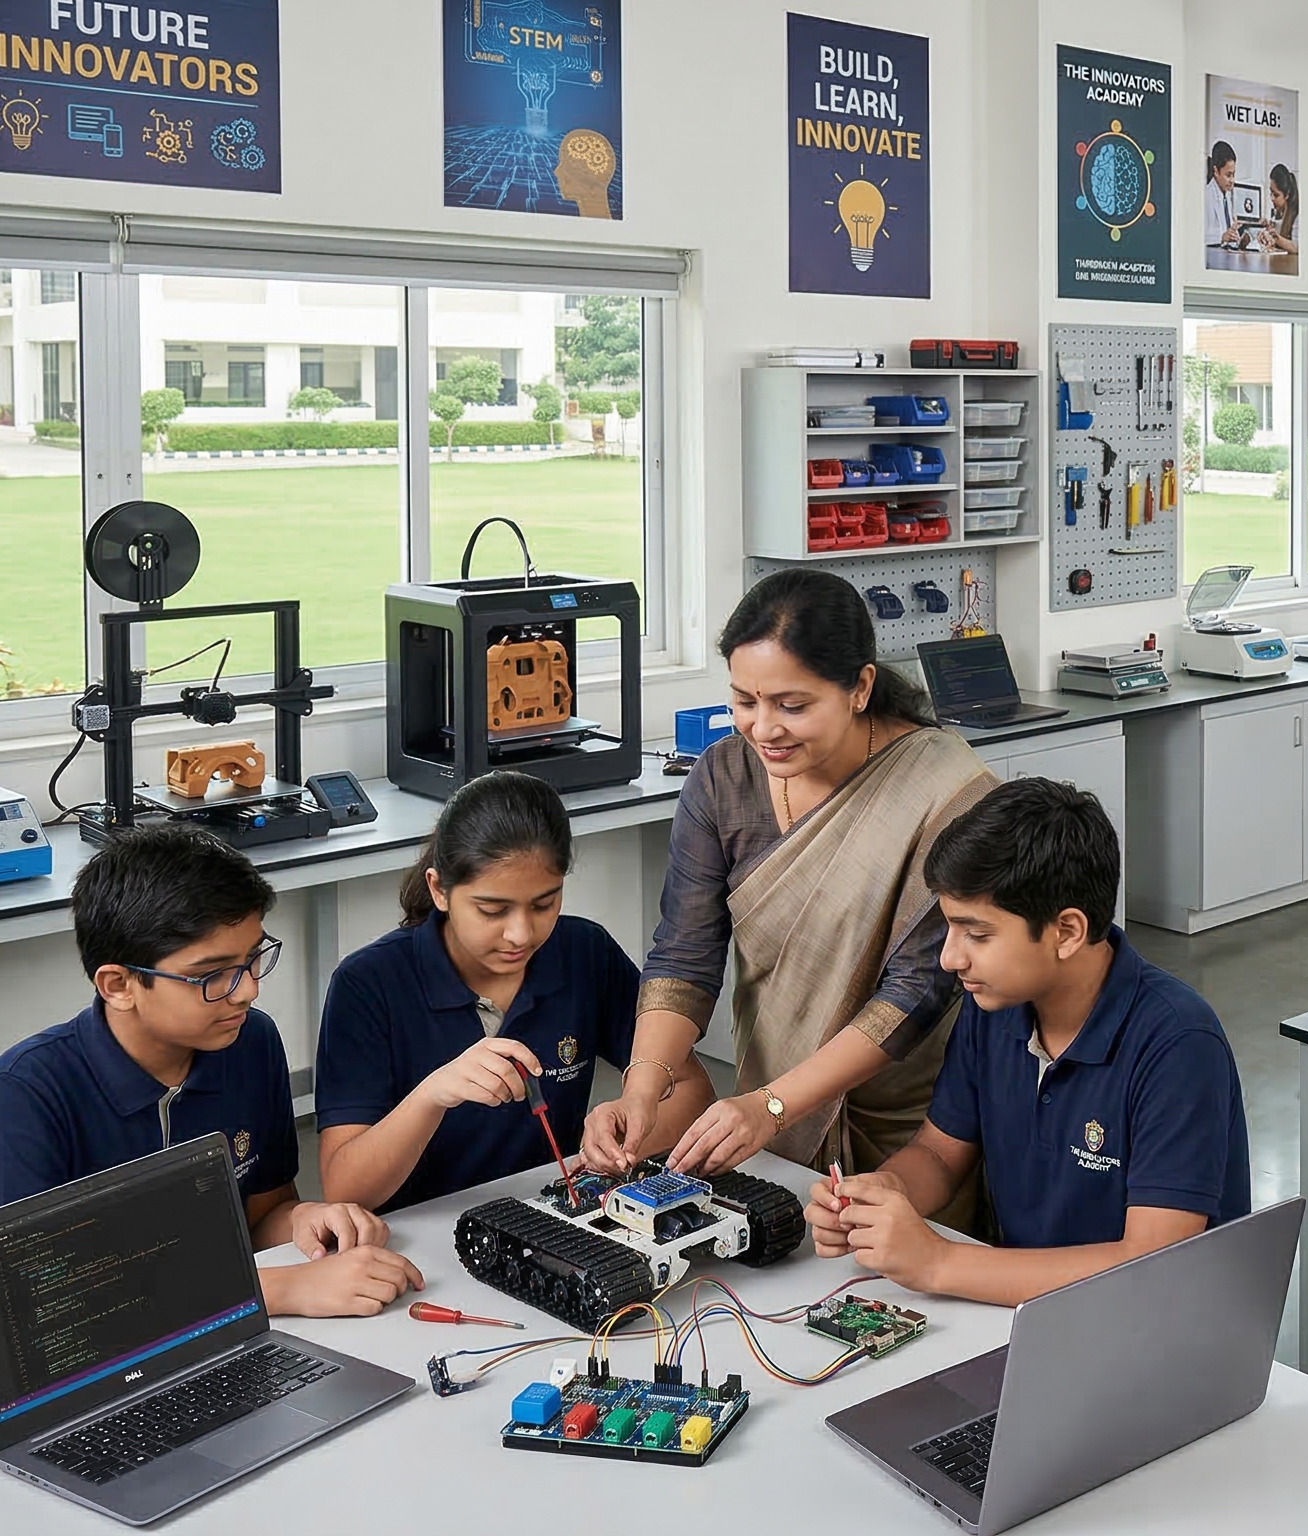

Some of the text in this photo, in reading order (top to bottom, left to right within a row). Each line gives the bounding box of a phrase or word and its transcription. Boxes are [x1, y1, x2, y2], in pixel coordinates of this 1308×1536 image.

[51, 0, 209, 49] FUTURE
[509, 26, 563, 52] STEM
[0, 33, 259, 96] INNOVATORS
[820, 45, 899, 90] BUILD,
[1064, 63, 1165, 94] THE INNOVATORS
[815, 82, 904, 127] LEARN,
[1086, 86, 1144, 108] ACADEMY
[1225, 103, 1281, 128] WET LAB:
[797, 117, 921, 160] INNOVATE
